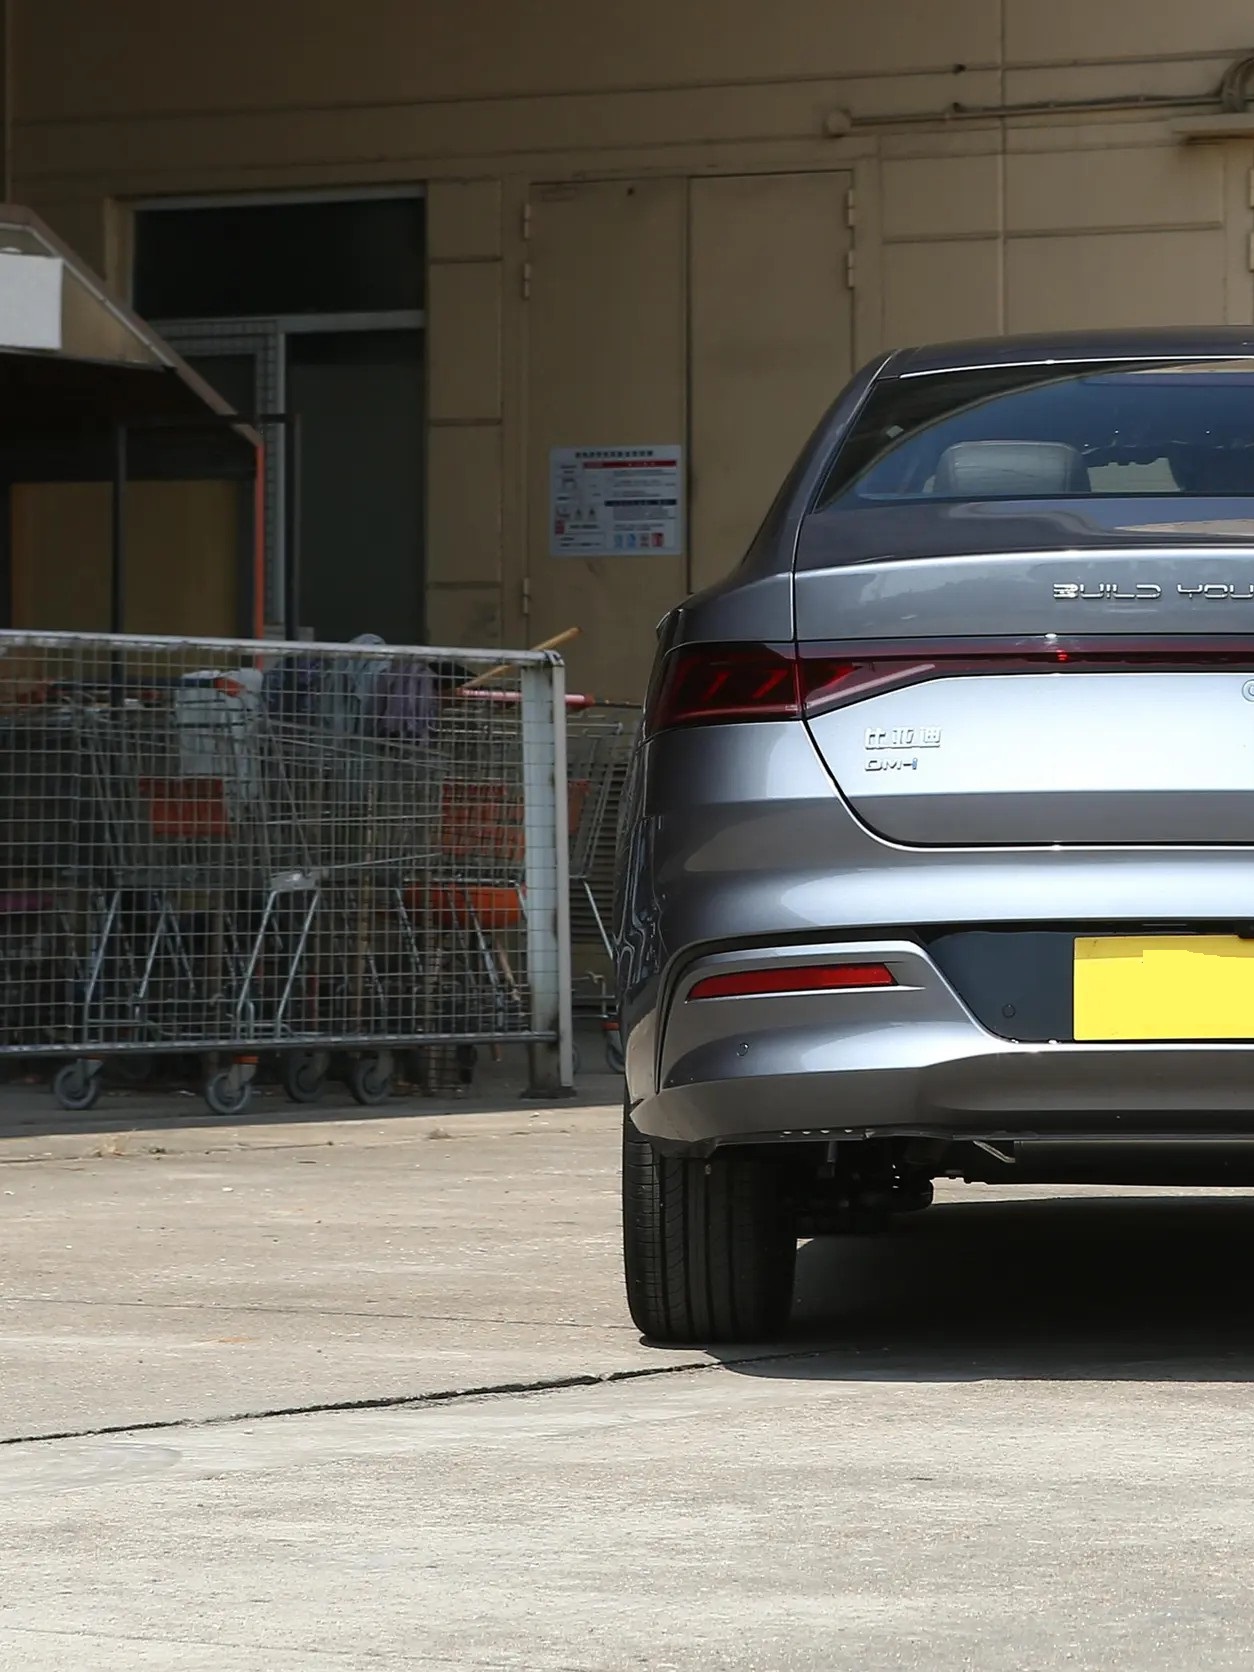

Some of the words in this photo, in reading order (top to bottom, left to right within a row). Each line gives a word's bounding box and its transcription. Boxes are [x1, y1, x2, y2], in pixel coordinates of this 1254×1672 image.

[1053, 583, 1161, 599] BUILD
[865, 727, 941, 755] 比亚迪
